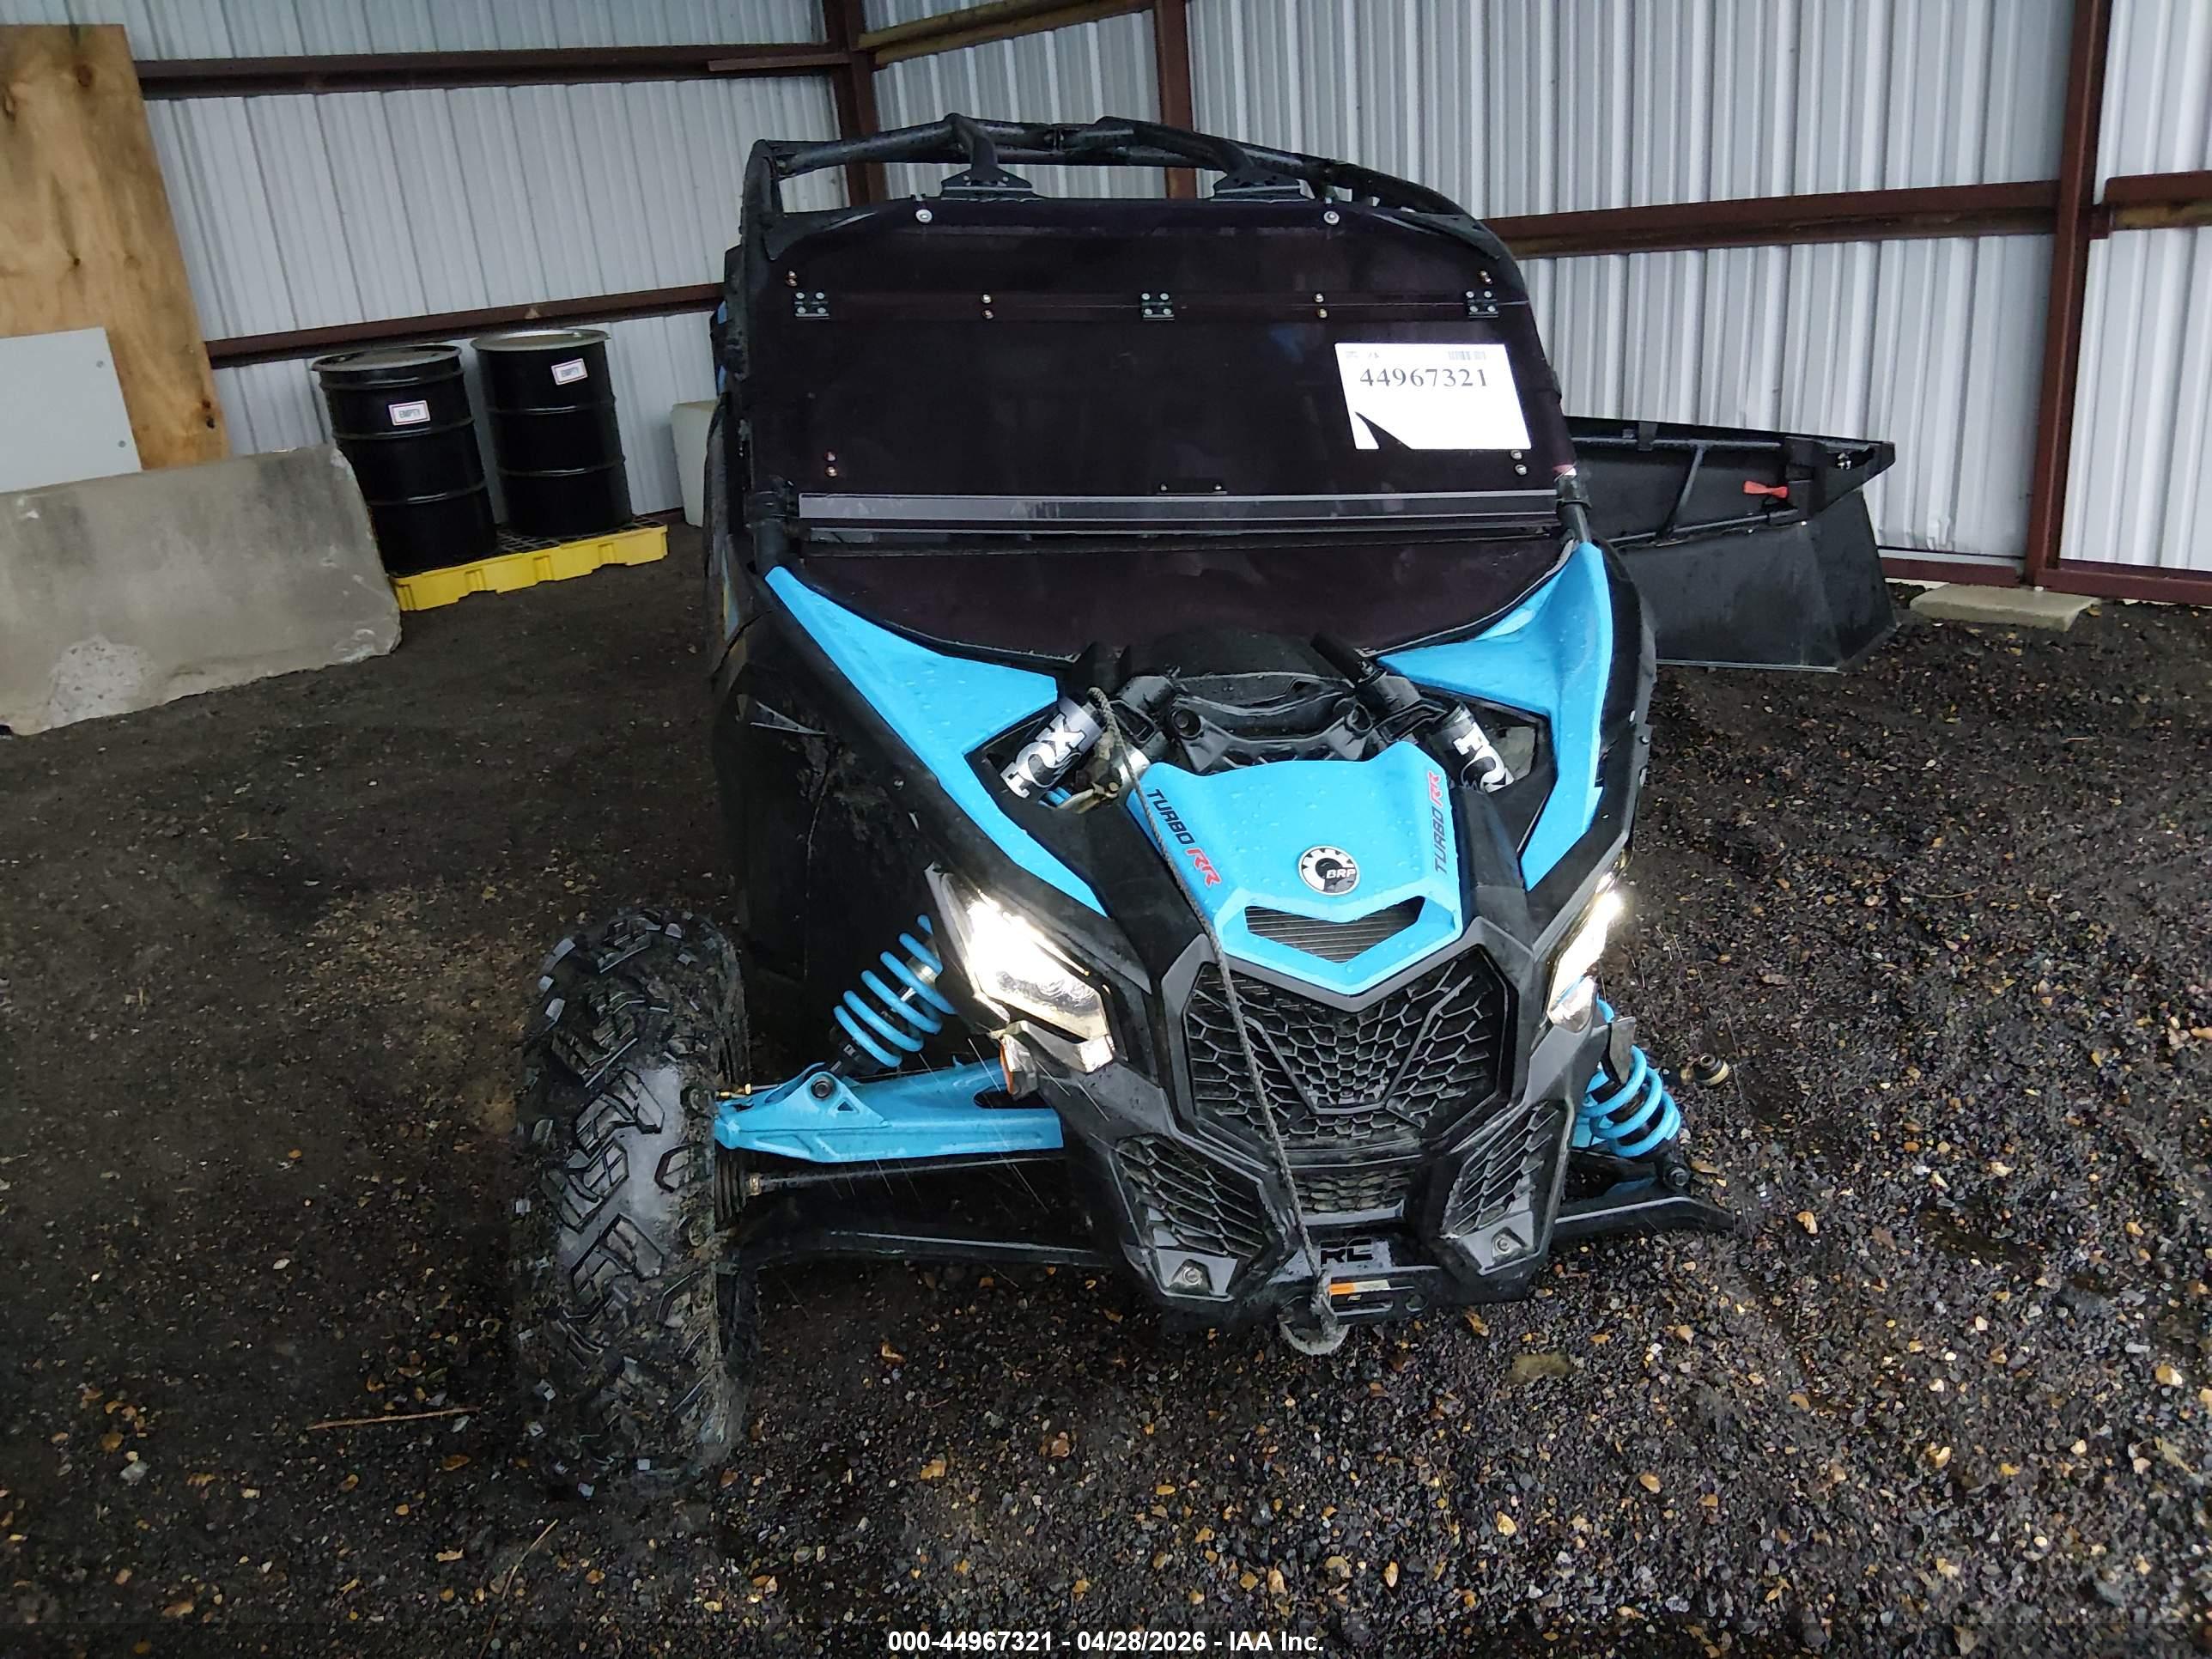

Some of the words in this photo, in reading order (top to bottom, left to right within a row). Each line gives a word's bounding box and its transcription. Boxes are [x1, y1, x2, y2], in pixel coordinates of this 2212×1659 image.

[1359, 368, 1488, 387] 44967321
[1000, 713, 1085, 799] FOX
[1427, 770, 1444, 807] RR
[1146, 788, 1196, 845] TURBO
[1185, 847, 1222, 888] RR
[1431, 805, 1448, 874] TURBO
[1326, 867, 1357, 879] BRP
